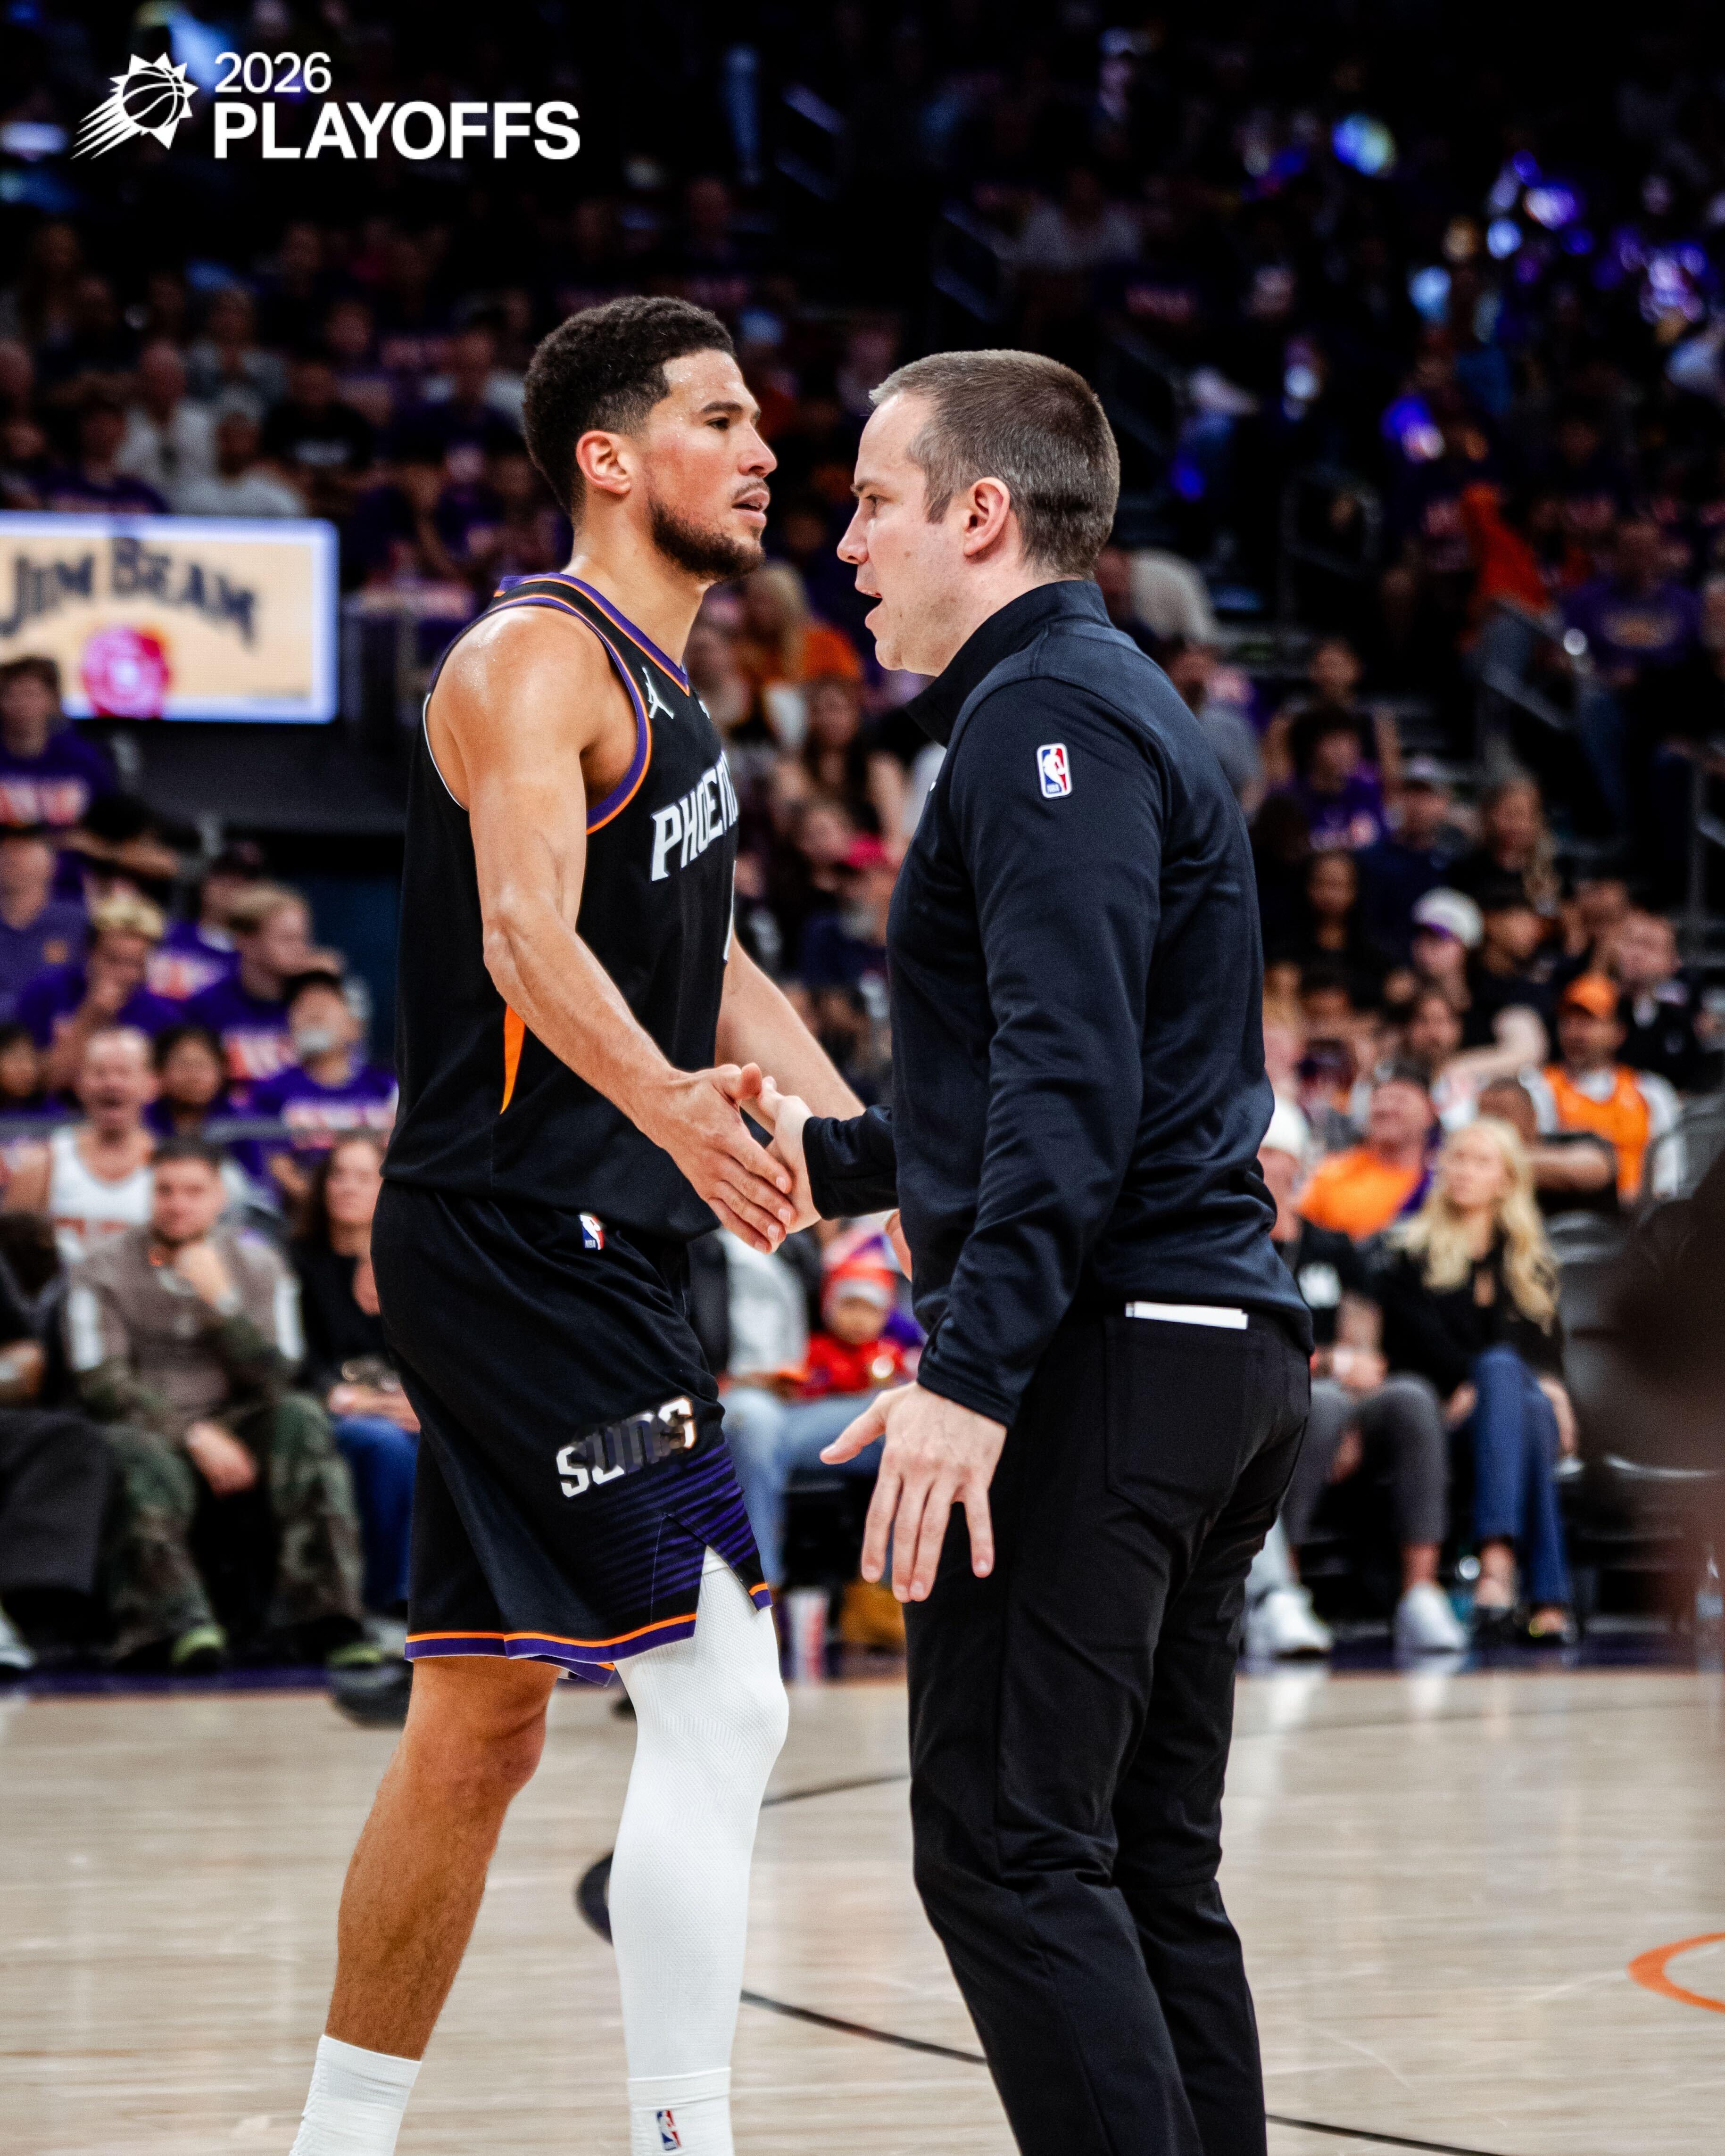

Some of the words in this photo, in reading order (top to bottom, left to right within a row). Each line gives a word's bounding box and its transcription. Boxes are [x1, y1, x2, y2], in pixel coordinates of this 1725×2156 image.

[0, 551, 94, 637] JIM
[109, 537, 259, 653] BEAM
[651, 750, 738, 882] PHOEN
[556, 1396, 697, 1498] SUNS
